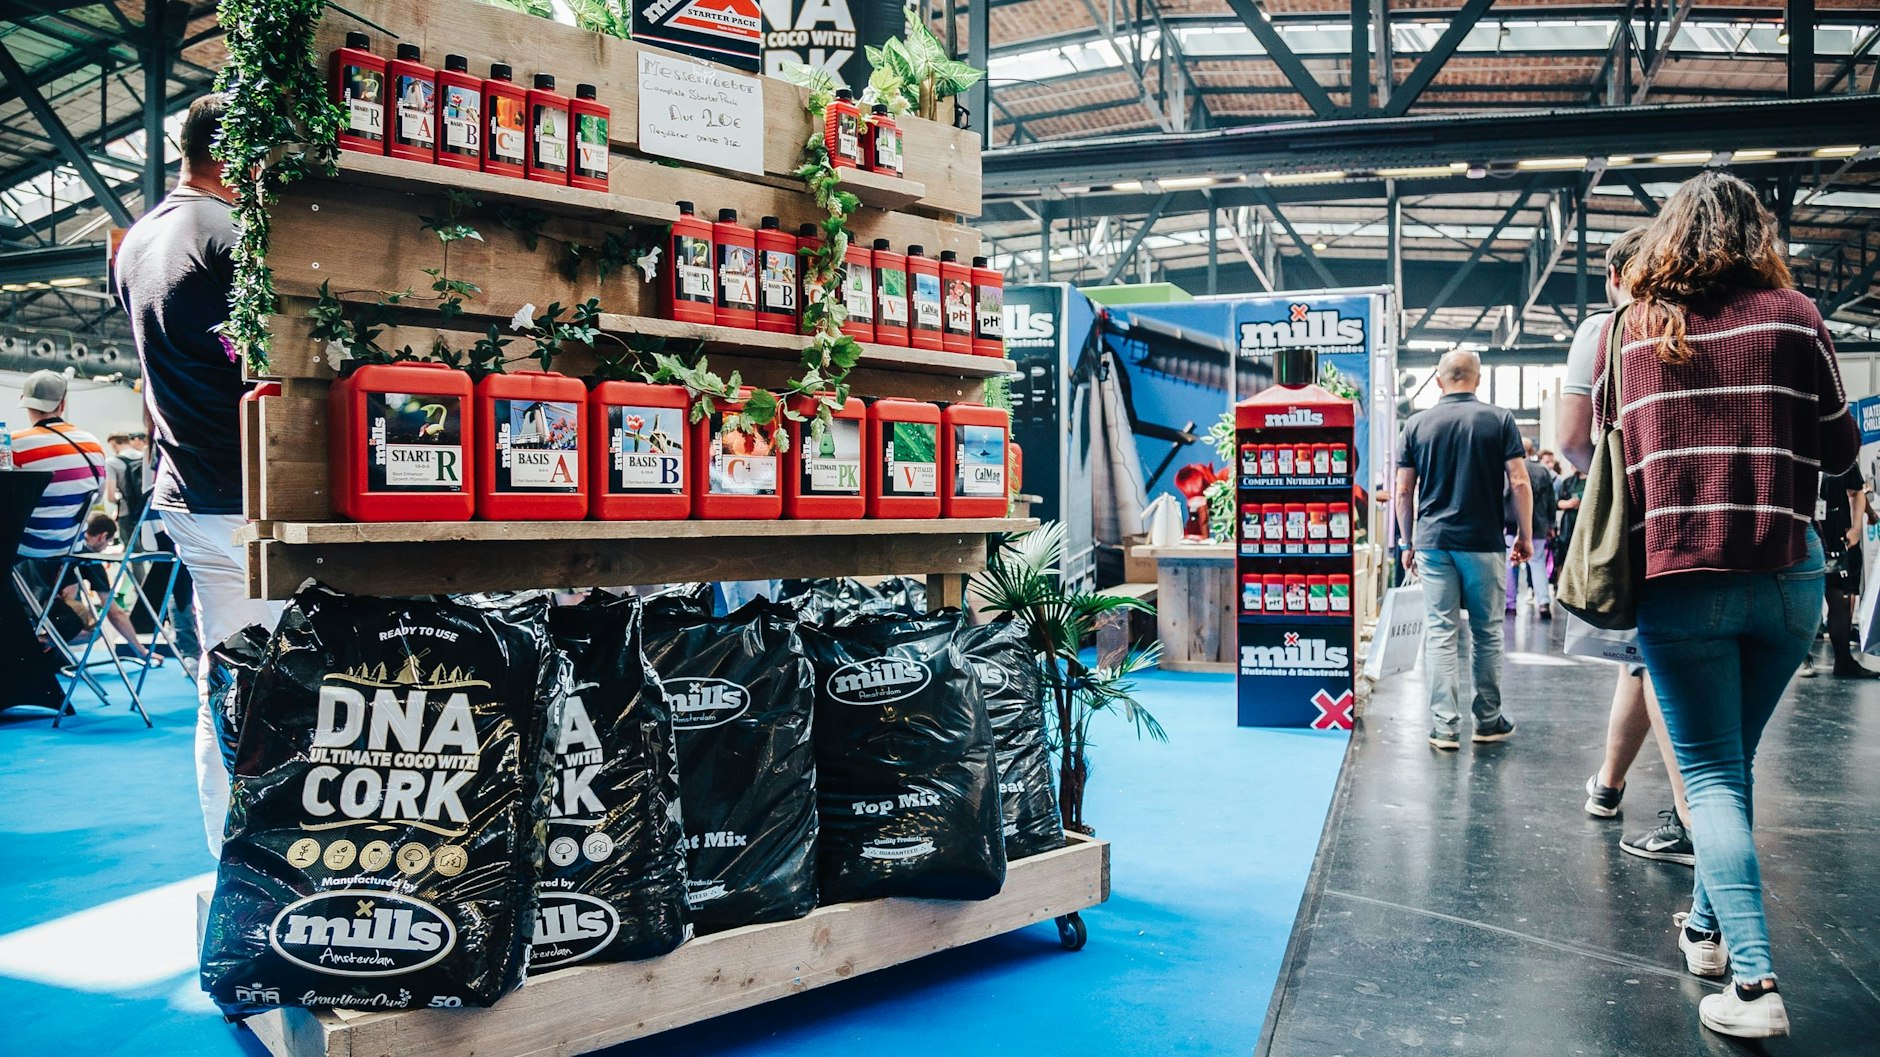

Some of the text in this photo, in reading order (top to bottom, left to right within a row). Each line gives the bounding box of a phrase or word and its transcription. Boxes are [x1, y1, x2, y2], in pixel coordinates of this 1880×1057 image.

[687, 8, 730, 23] STARTER
[731, 17, 757, 28] PACK
[767, 31, 809, 48] COCO
[811, 31, 856, 47] WITH
[369, 108, 380, 127] R
[417, 116, 432, 138] A
[465, 123, 478, 145] B
[701, 273, 711, 292] R
[739, 280, 752, 301] A
[782, 285, 793, 306] B
[1241, 304, 1364, 348] mills
[1265, 406, 1323, 427] mills
[372, 417, 386, 465] mills
[499, 423, 511, 468] mills
[612, 428, 623, 471] mills
[518, 453, 574, 483] BASIS A
[629, 456, 680, 484] BASIS B
[838, 464, 859, 488] PK
[974, 467, 1001, 485] CalMag
[1243, 476, 1347, 486] COMPLETE NUTRIENT LINE
[379, 626, 459, 642] READY TO USE
[1390, 622, 1422, 638] NARCOS
[1241, 631, 1349, 669] mills
[834, 662, 923, 694] mills
[1241, 668, 1350, 677] Nutrients & Substrates
[858, 687, 902, 700] Amsterdam
[313, 686, 480, 754] DNA
[671, 713, 716, 723] Amsterdam
[310, 748, 480, 771] ULTIMATE COCO WITH
[564, 748, 604, 768] WITH
[301, 766, 470, 824] CORK
[852, 791, 941, 815] Top Mix
[704, 831, 747, 848] Mix
[321, 875, 418, 892] Manufactured by
[561, 878, 575, 889] by
[284, 900, 442, 951] mills
[532, 904, 608, 946] ills
[319, 947, 395, 966] Amsterdam
[235, 989, 281, 1005] DNA
